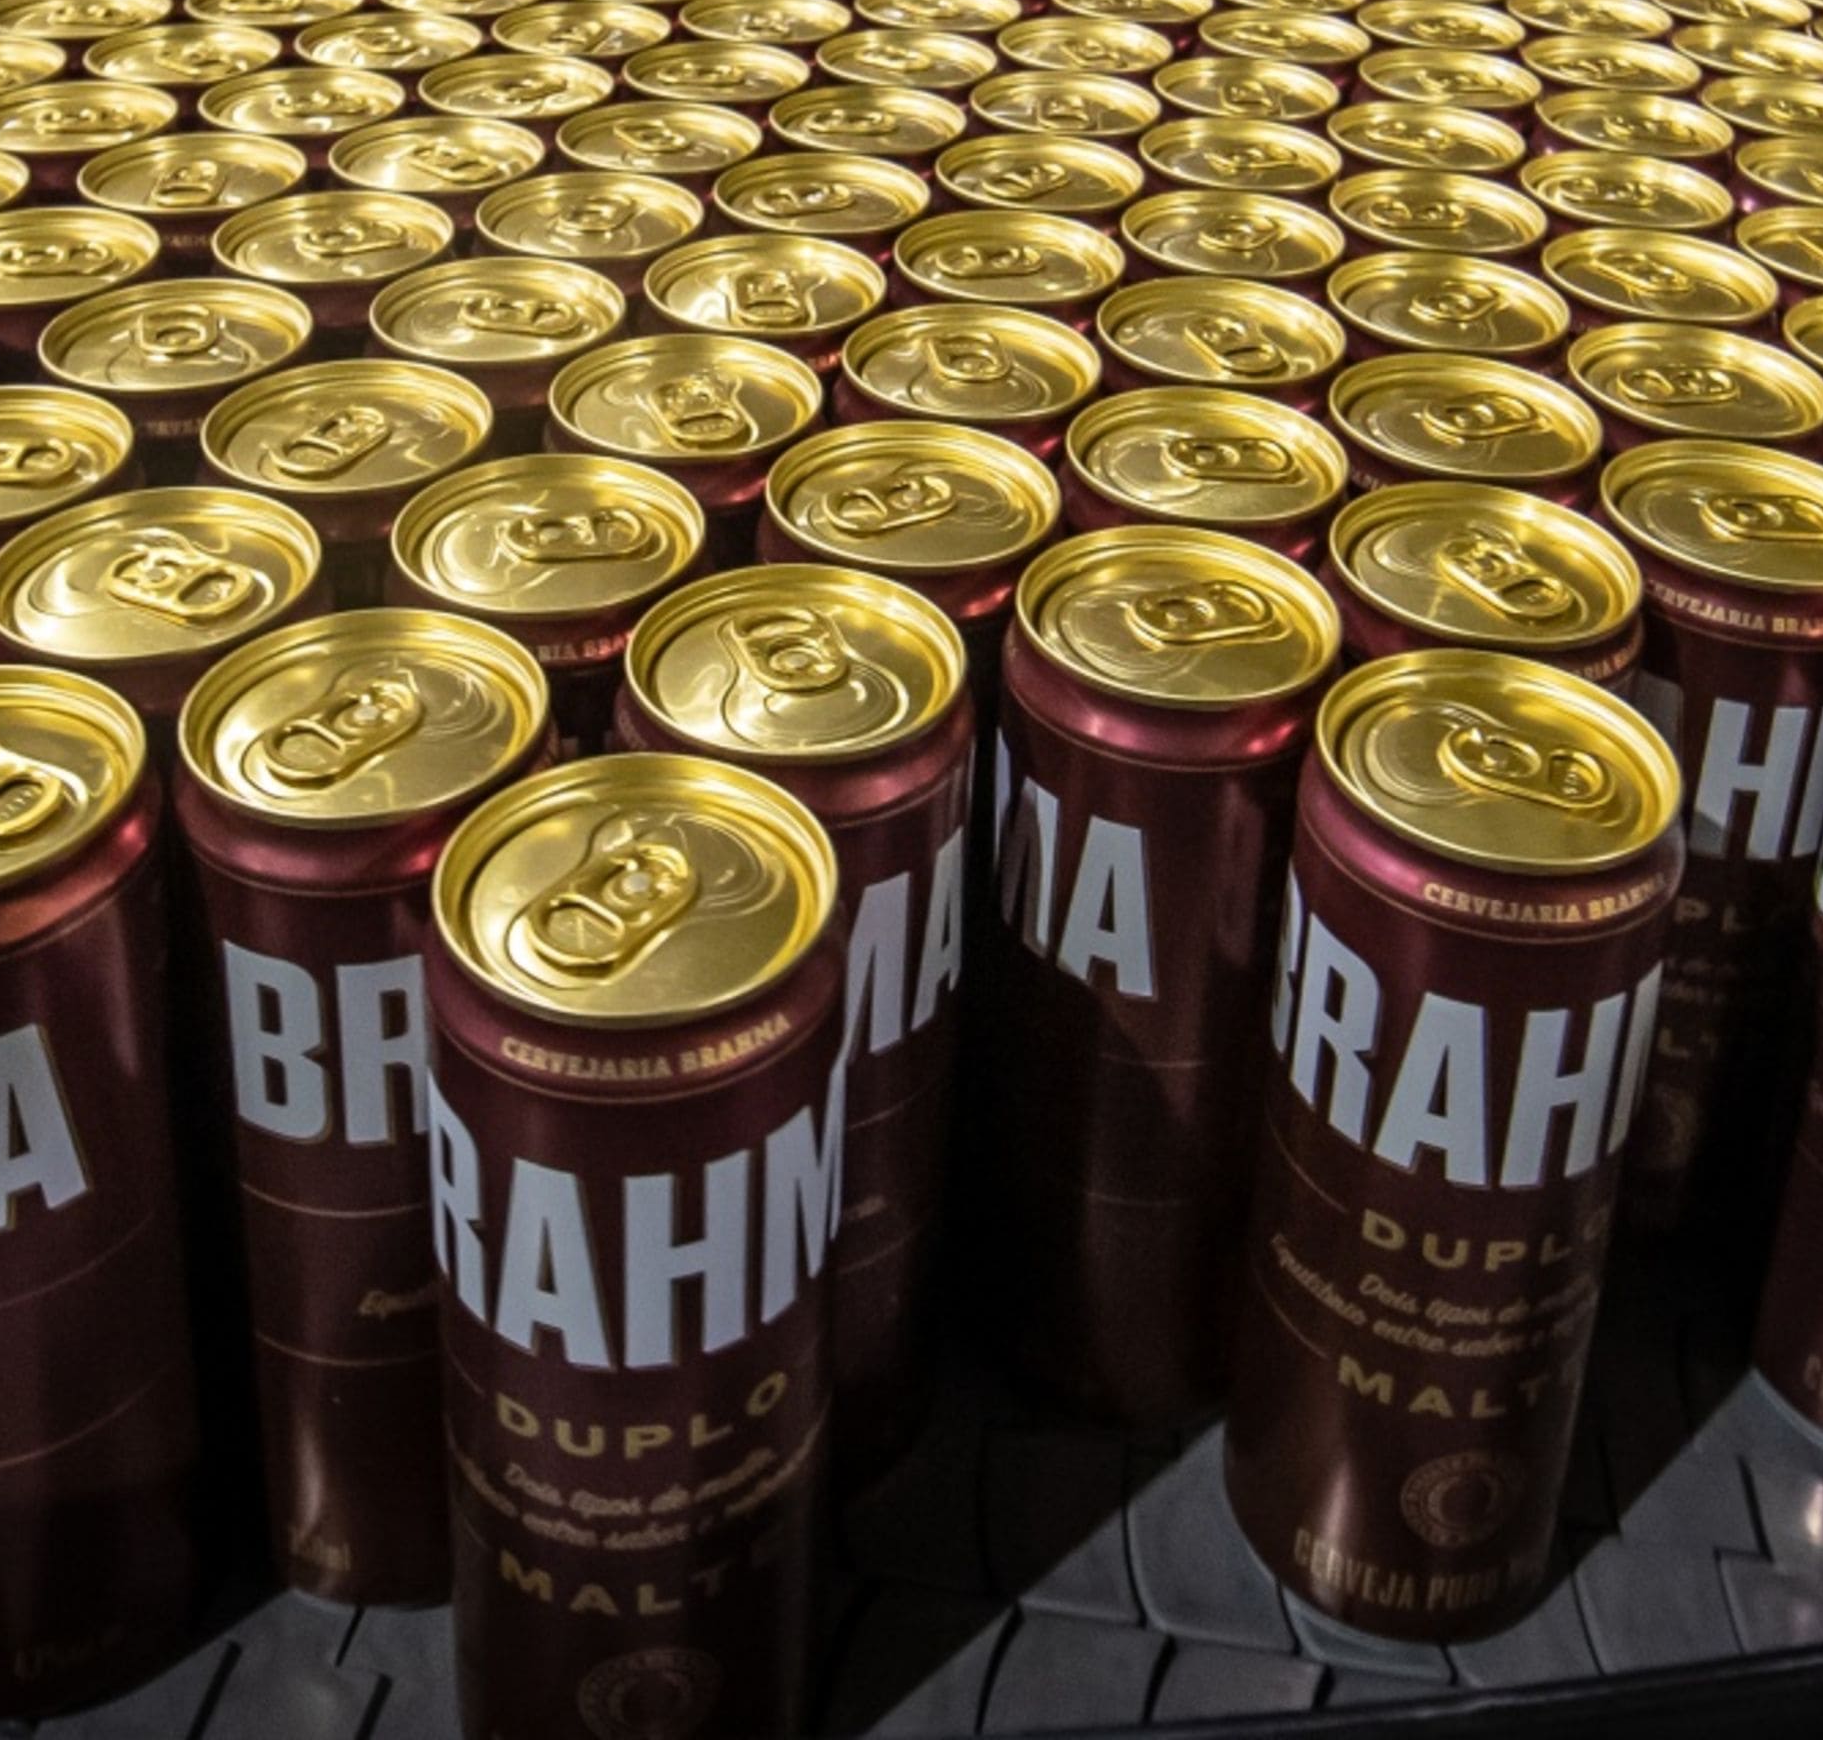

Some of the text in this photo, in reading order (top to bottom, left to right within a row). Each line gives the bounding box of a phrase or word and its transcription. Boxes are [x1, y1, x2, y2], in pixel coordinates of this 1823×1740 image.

[1423, 882, 1585, 924] CERVEJARIA
[500, 1011, 793, 1082] CERVEJARIA BRAHMA
[494, 1370, 789, 1459] DUPLO
[1335, 1354, 1578, 1421] MALT
[497, 1530, 784, 1618] MALT
